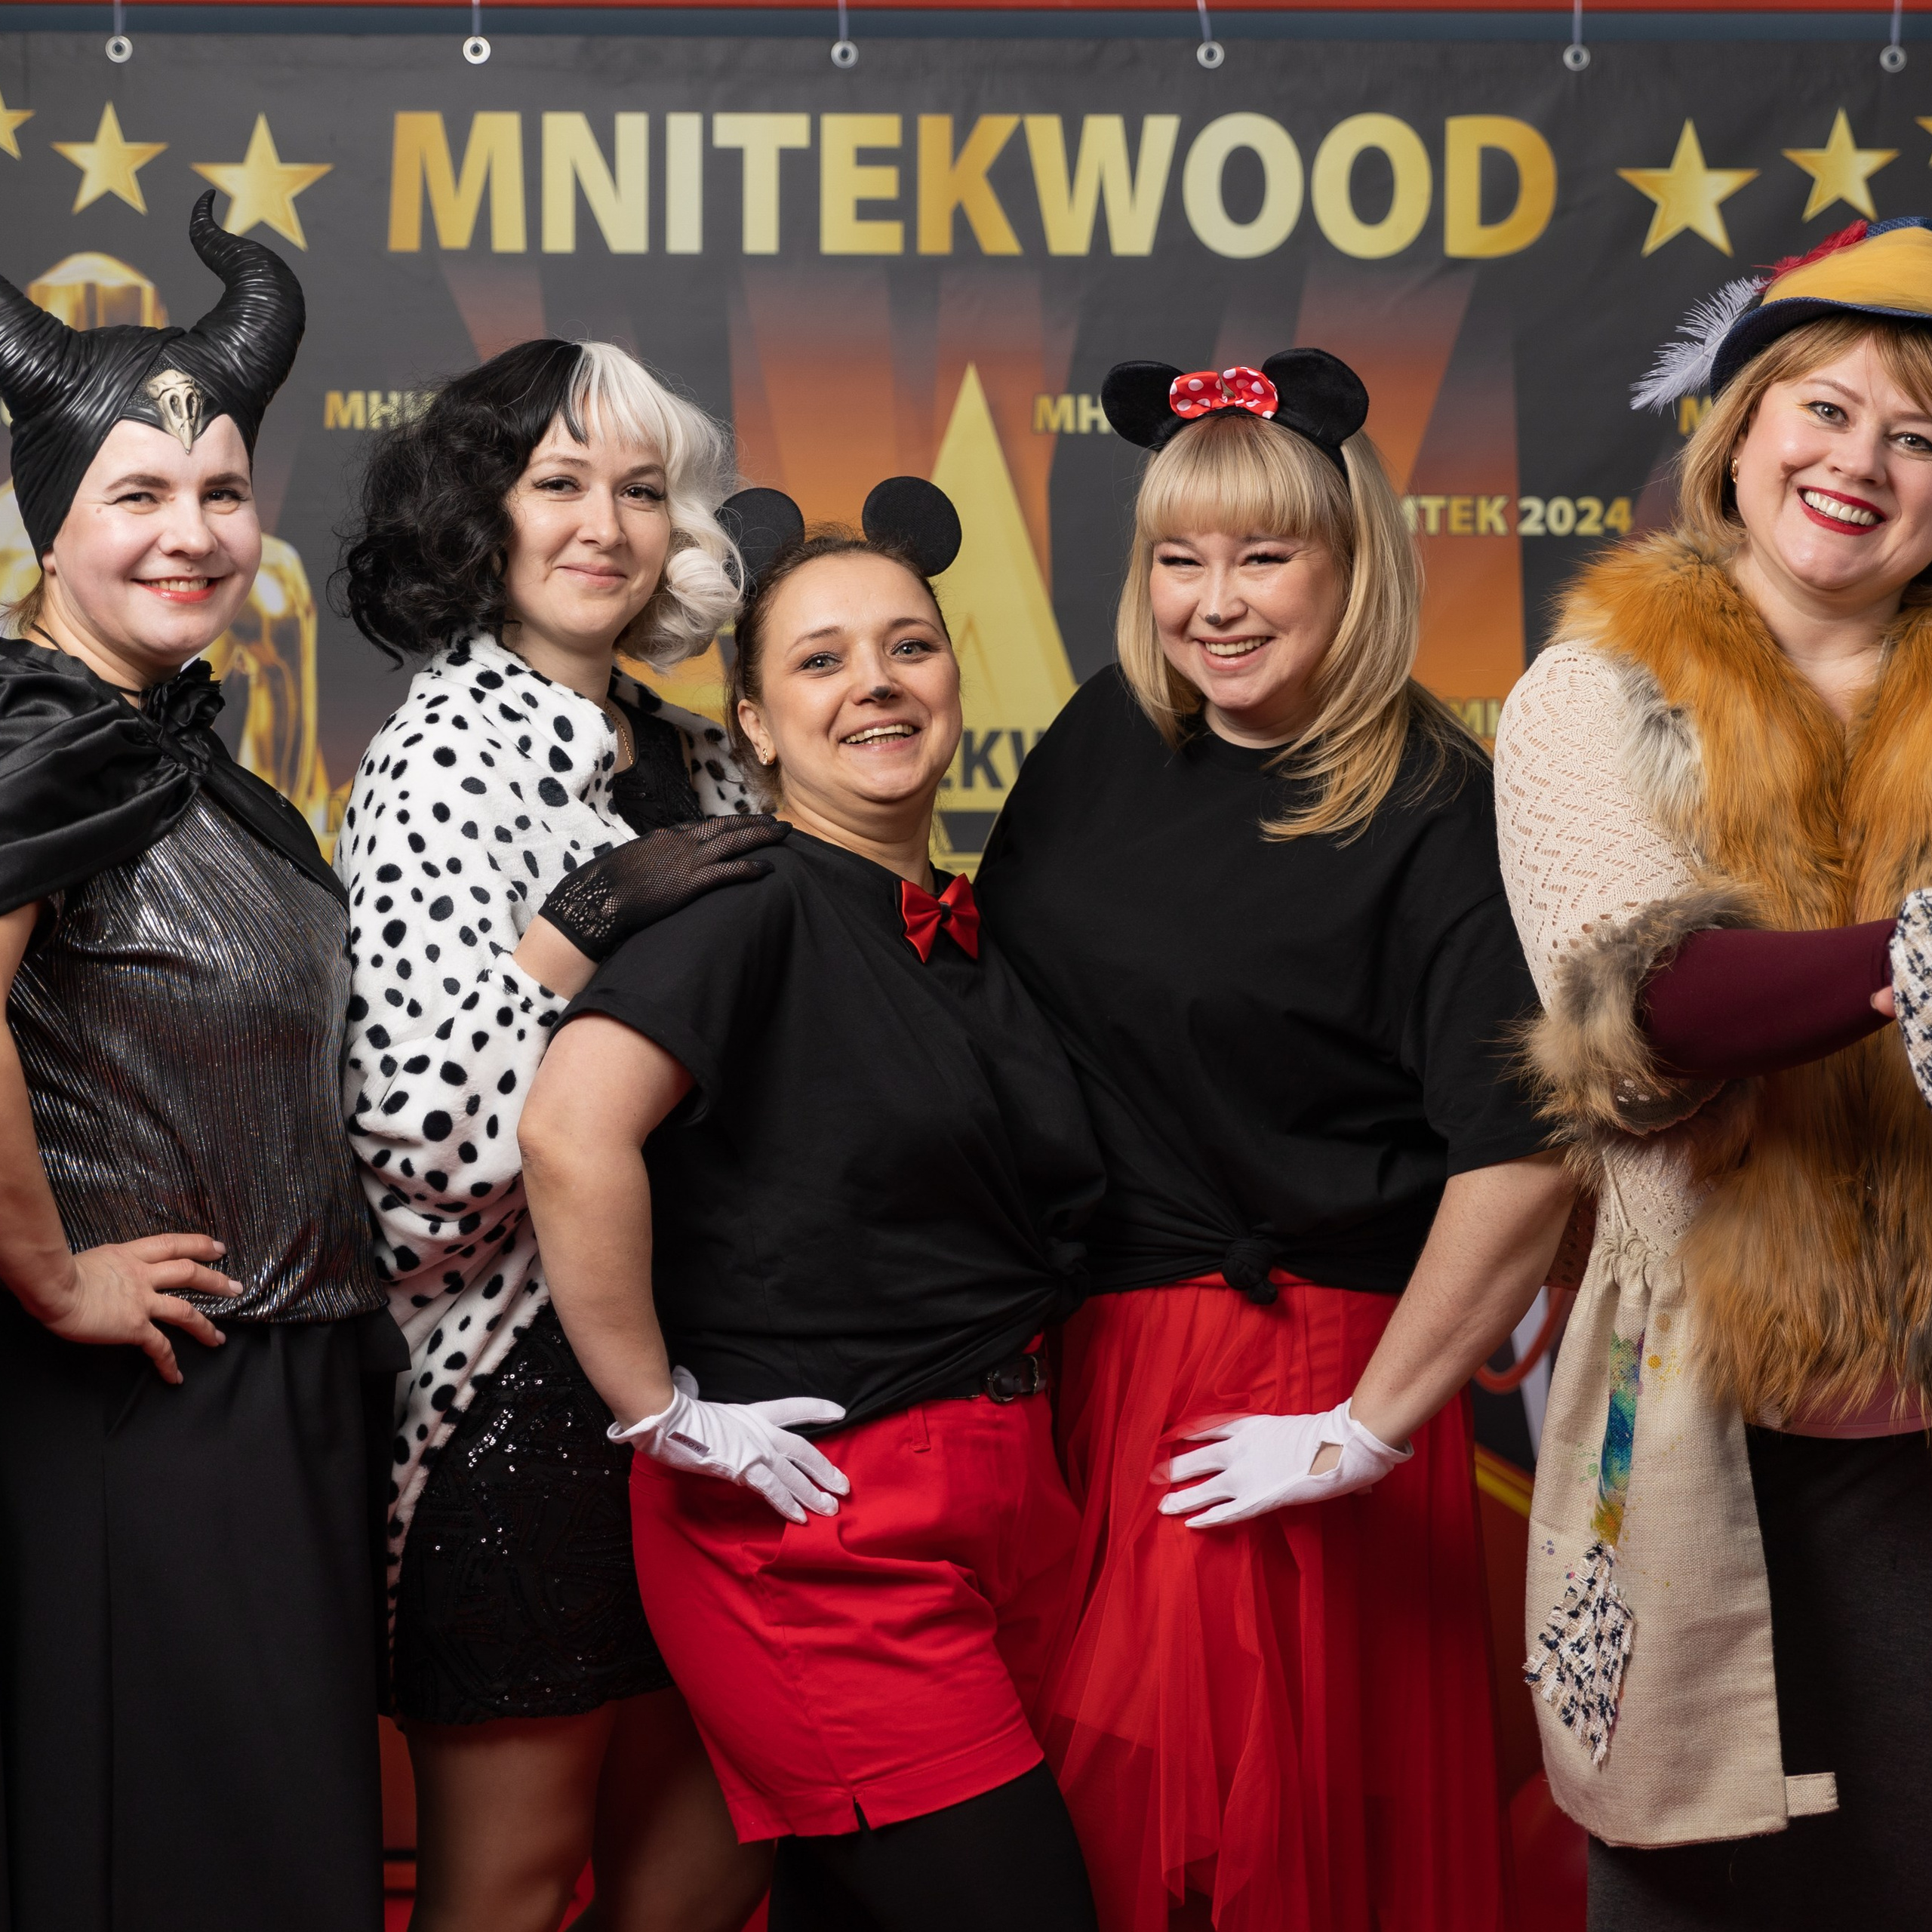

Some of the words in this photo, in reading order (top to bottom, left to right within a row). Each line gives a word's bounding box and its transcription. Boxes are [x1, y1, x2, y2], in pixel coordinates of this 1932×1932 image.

[388, 111, 1558, 259] MNITEKWOOD
[1518, 496, 1633, 536] 2024
[675, 1435, 702, 1452] AVON
